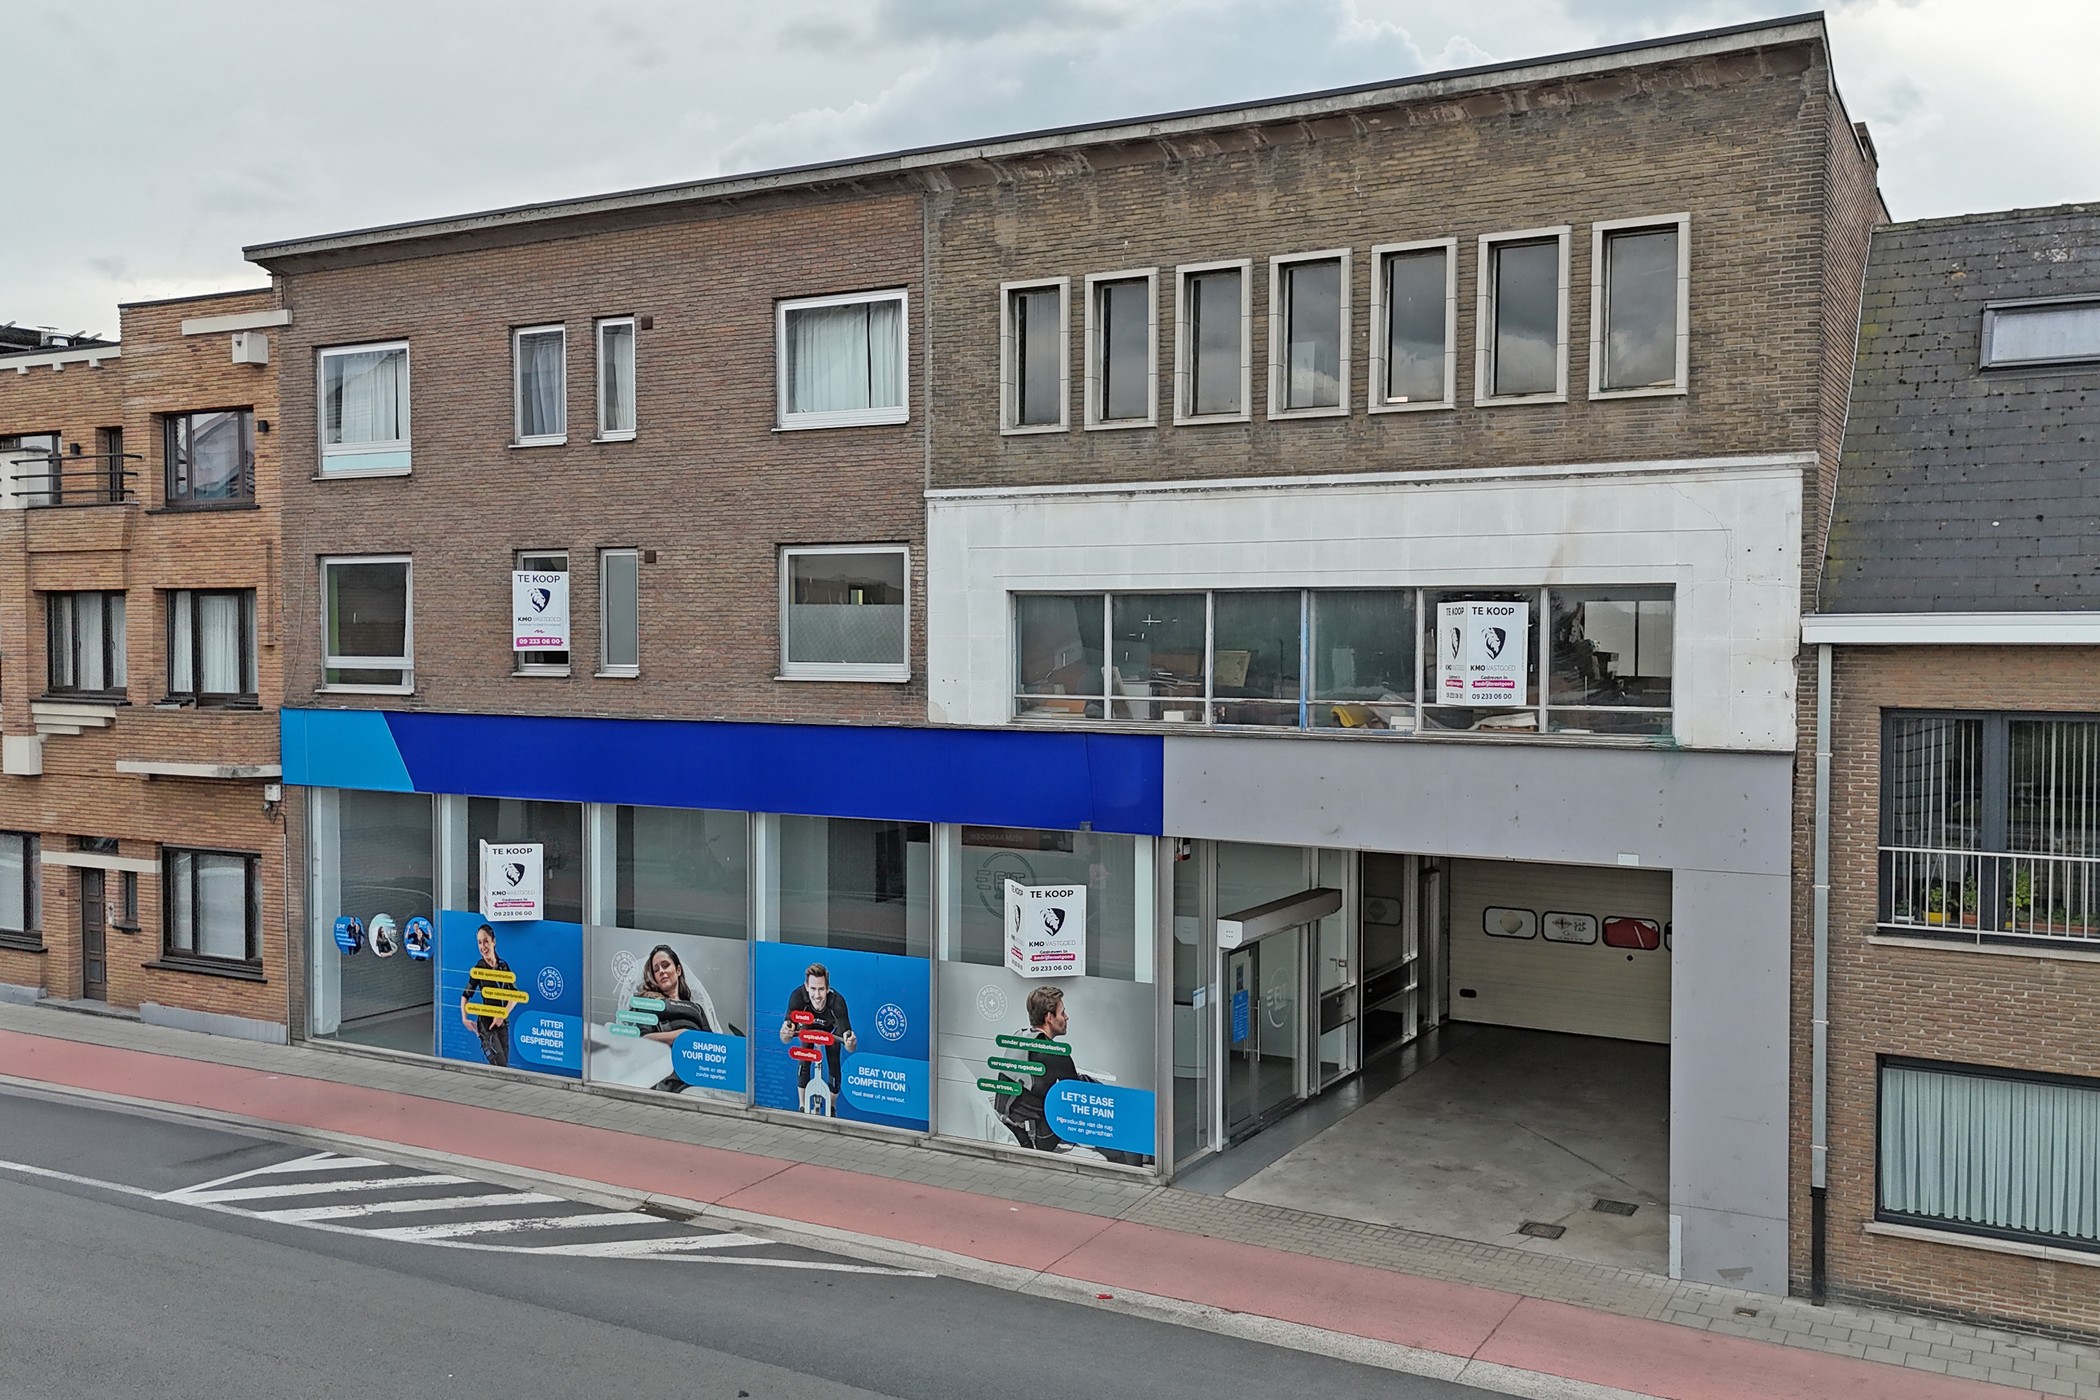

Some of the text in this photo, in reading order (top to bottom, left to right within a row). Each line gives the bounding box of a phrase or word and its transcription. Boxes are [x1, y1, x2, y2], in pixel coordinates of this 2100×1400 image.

[517, 574, 561, 583] TE KOOP
[1472, 607, 1515, 616] TE KOOP
[1029, 890, 1074, 898] TE KOOP
[547, 979, 554, 987] 20
[540, 1018, 564, 1030] FITTER
[887, 1018, 896, 1026] 20
[531, 1027, 564, 1039] SLANKER
[878, 1020, 900, 1038] MINUTEN
[520, 1034, 564, 1048] GESPIERDER
[692, 1041, 727, 1054] SHAPING
[681, 1049, 727, 1064] YOUR BODY
[858, 1066, 906, 1082] BEAT YOUR
[847, 1075, 906, 1093] COMPETITION
[1061, 1091, 1115, 1108] LET'S EASE
[1071, 1103, 1115, 1120] THE PAIN
